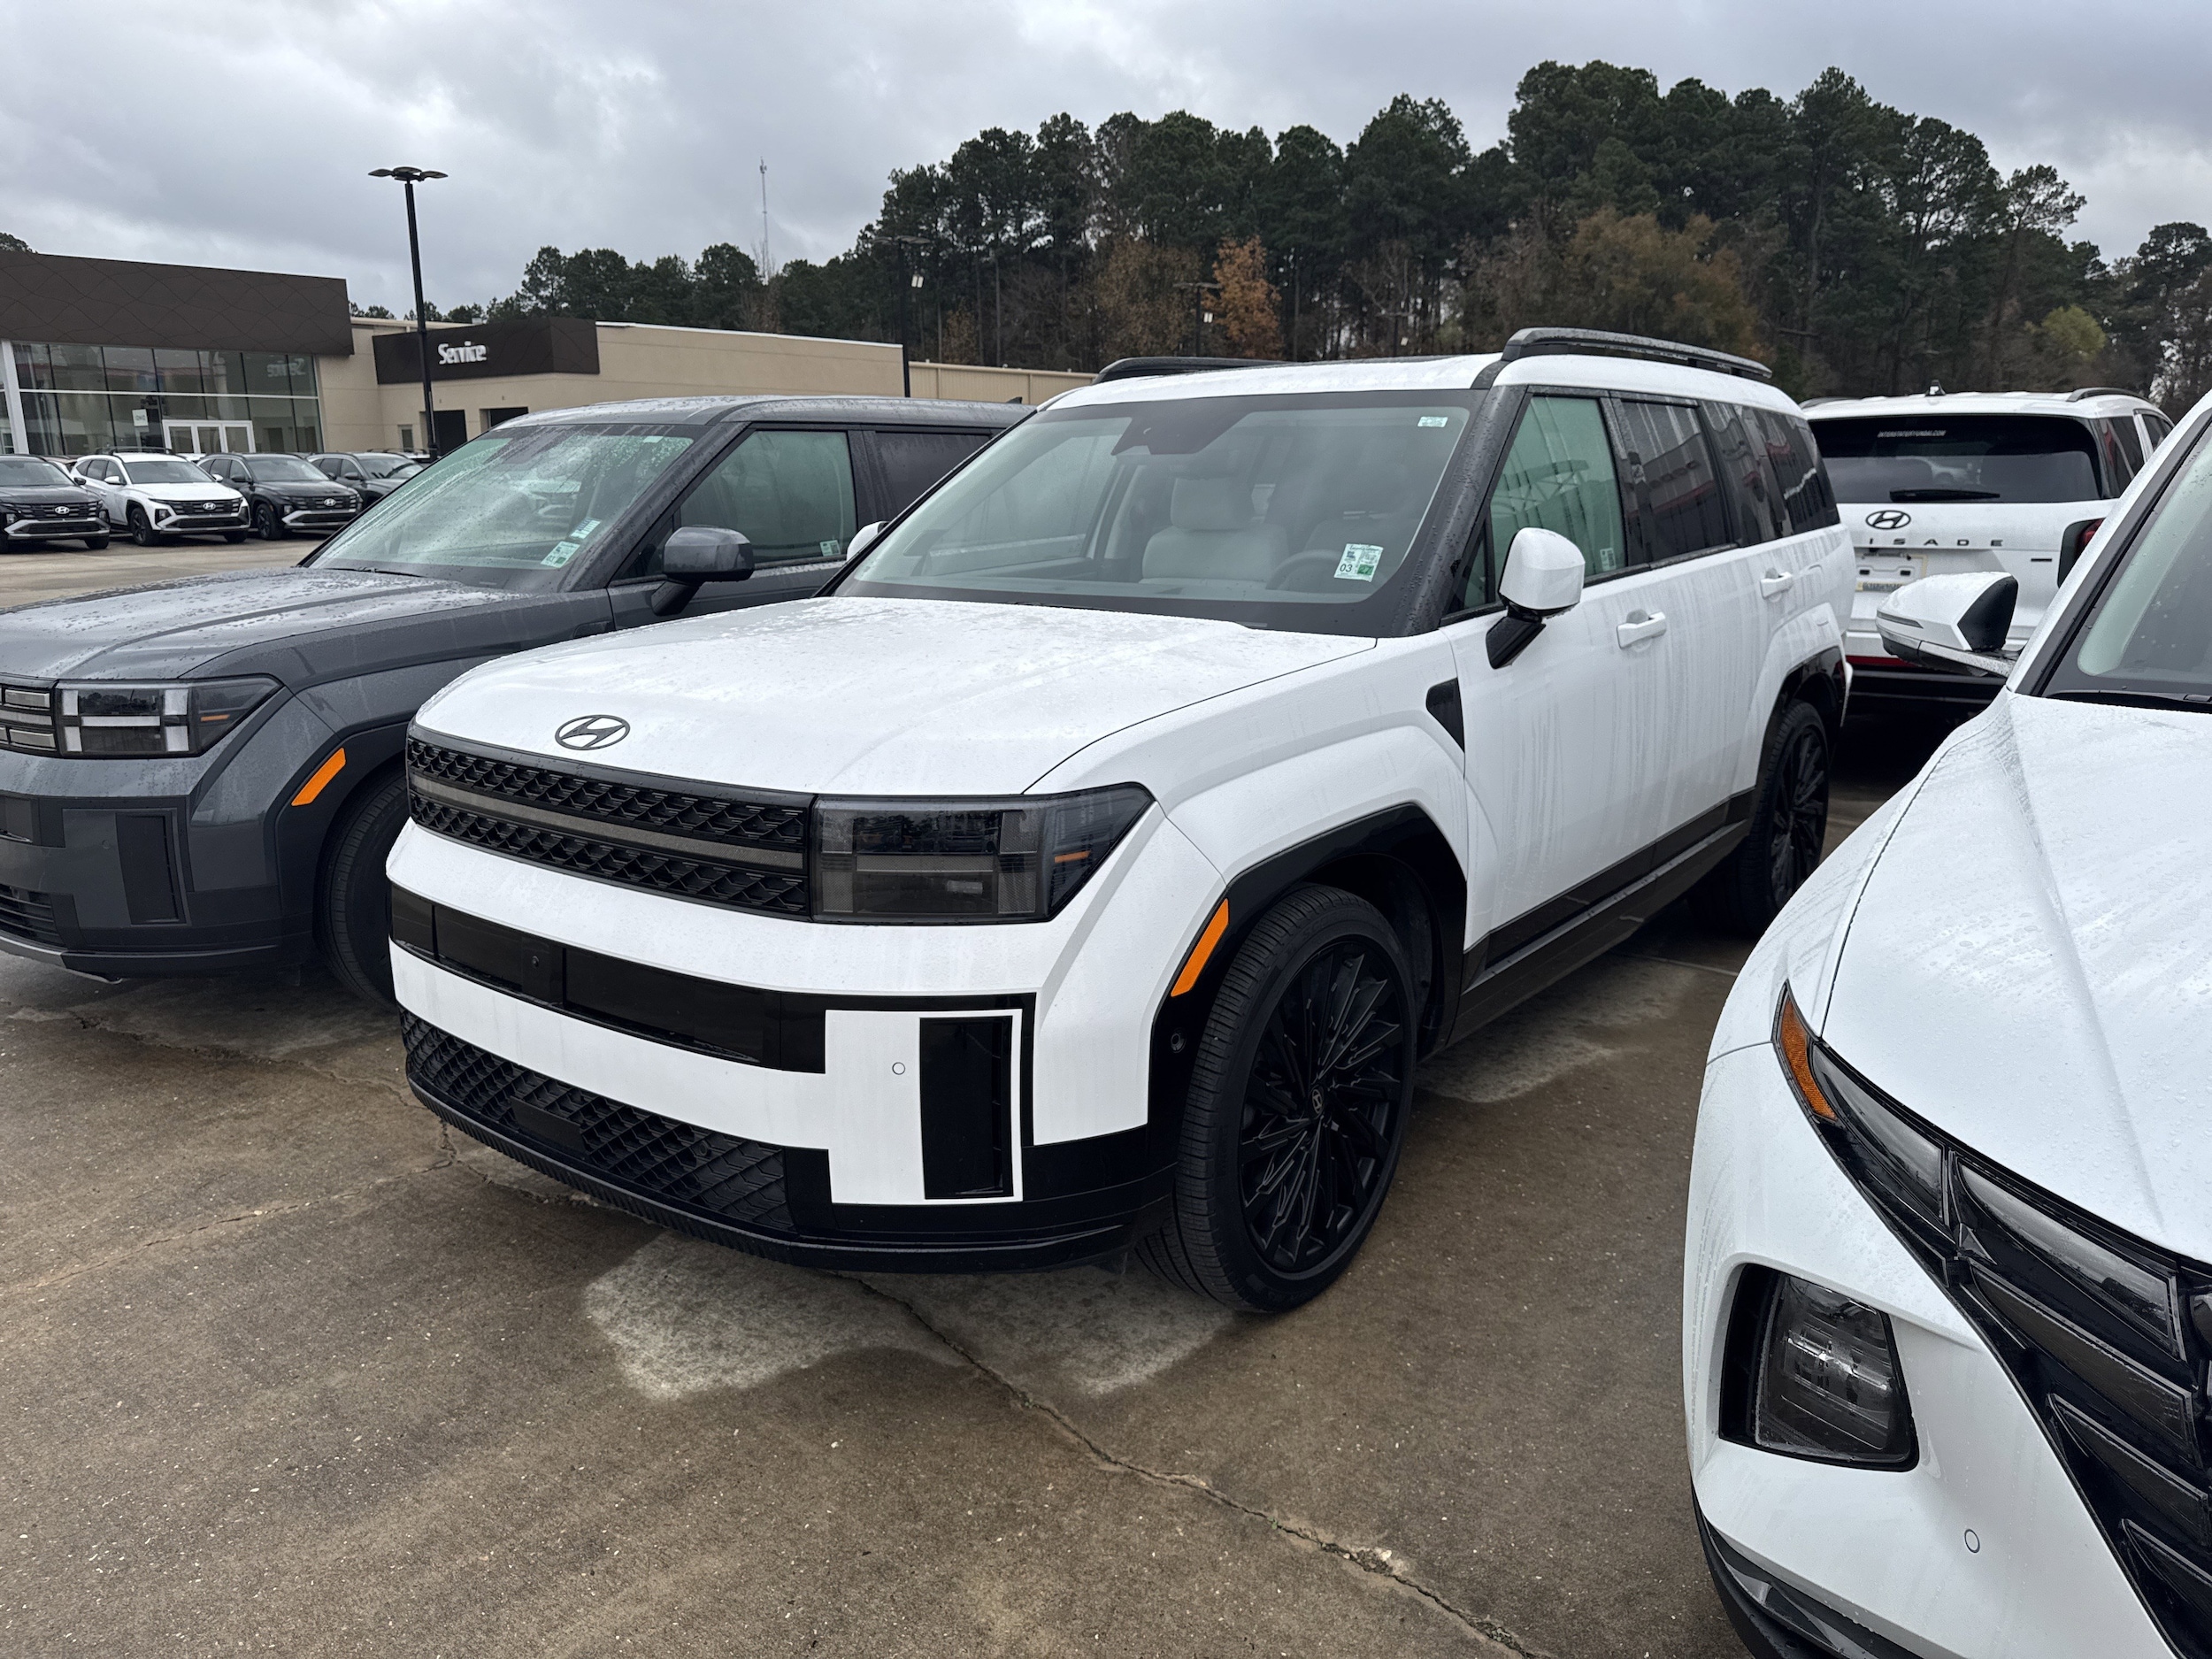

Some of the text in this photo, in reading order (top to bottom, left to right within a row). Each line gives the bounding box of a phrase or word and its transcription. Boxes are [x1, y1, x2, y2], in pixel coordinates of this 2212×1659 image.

[438, 341, 487, 365] Service
[1870, 538, 2002, 547] ISADE
[1340, 564, 1353, 572] 03
